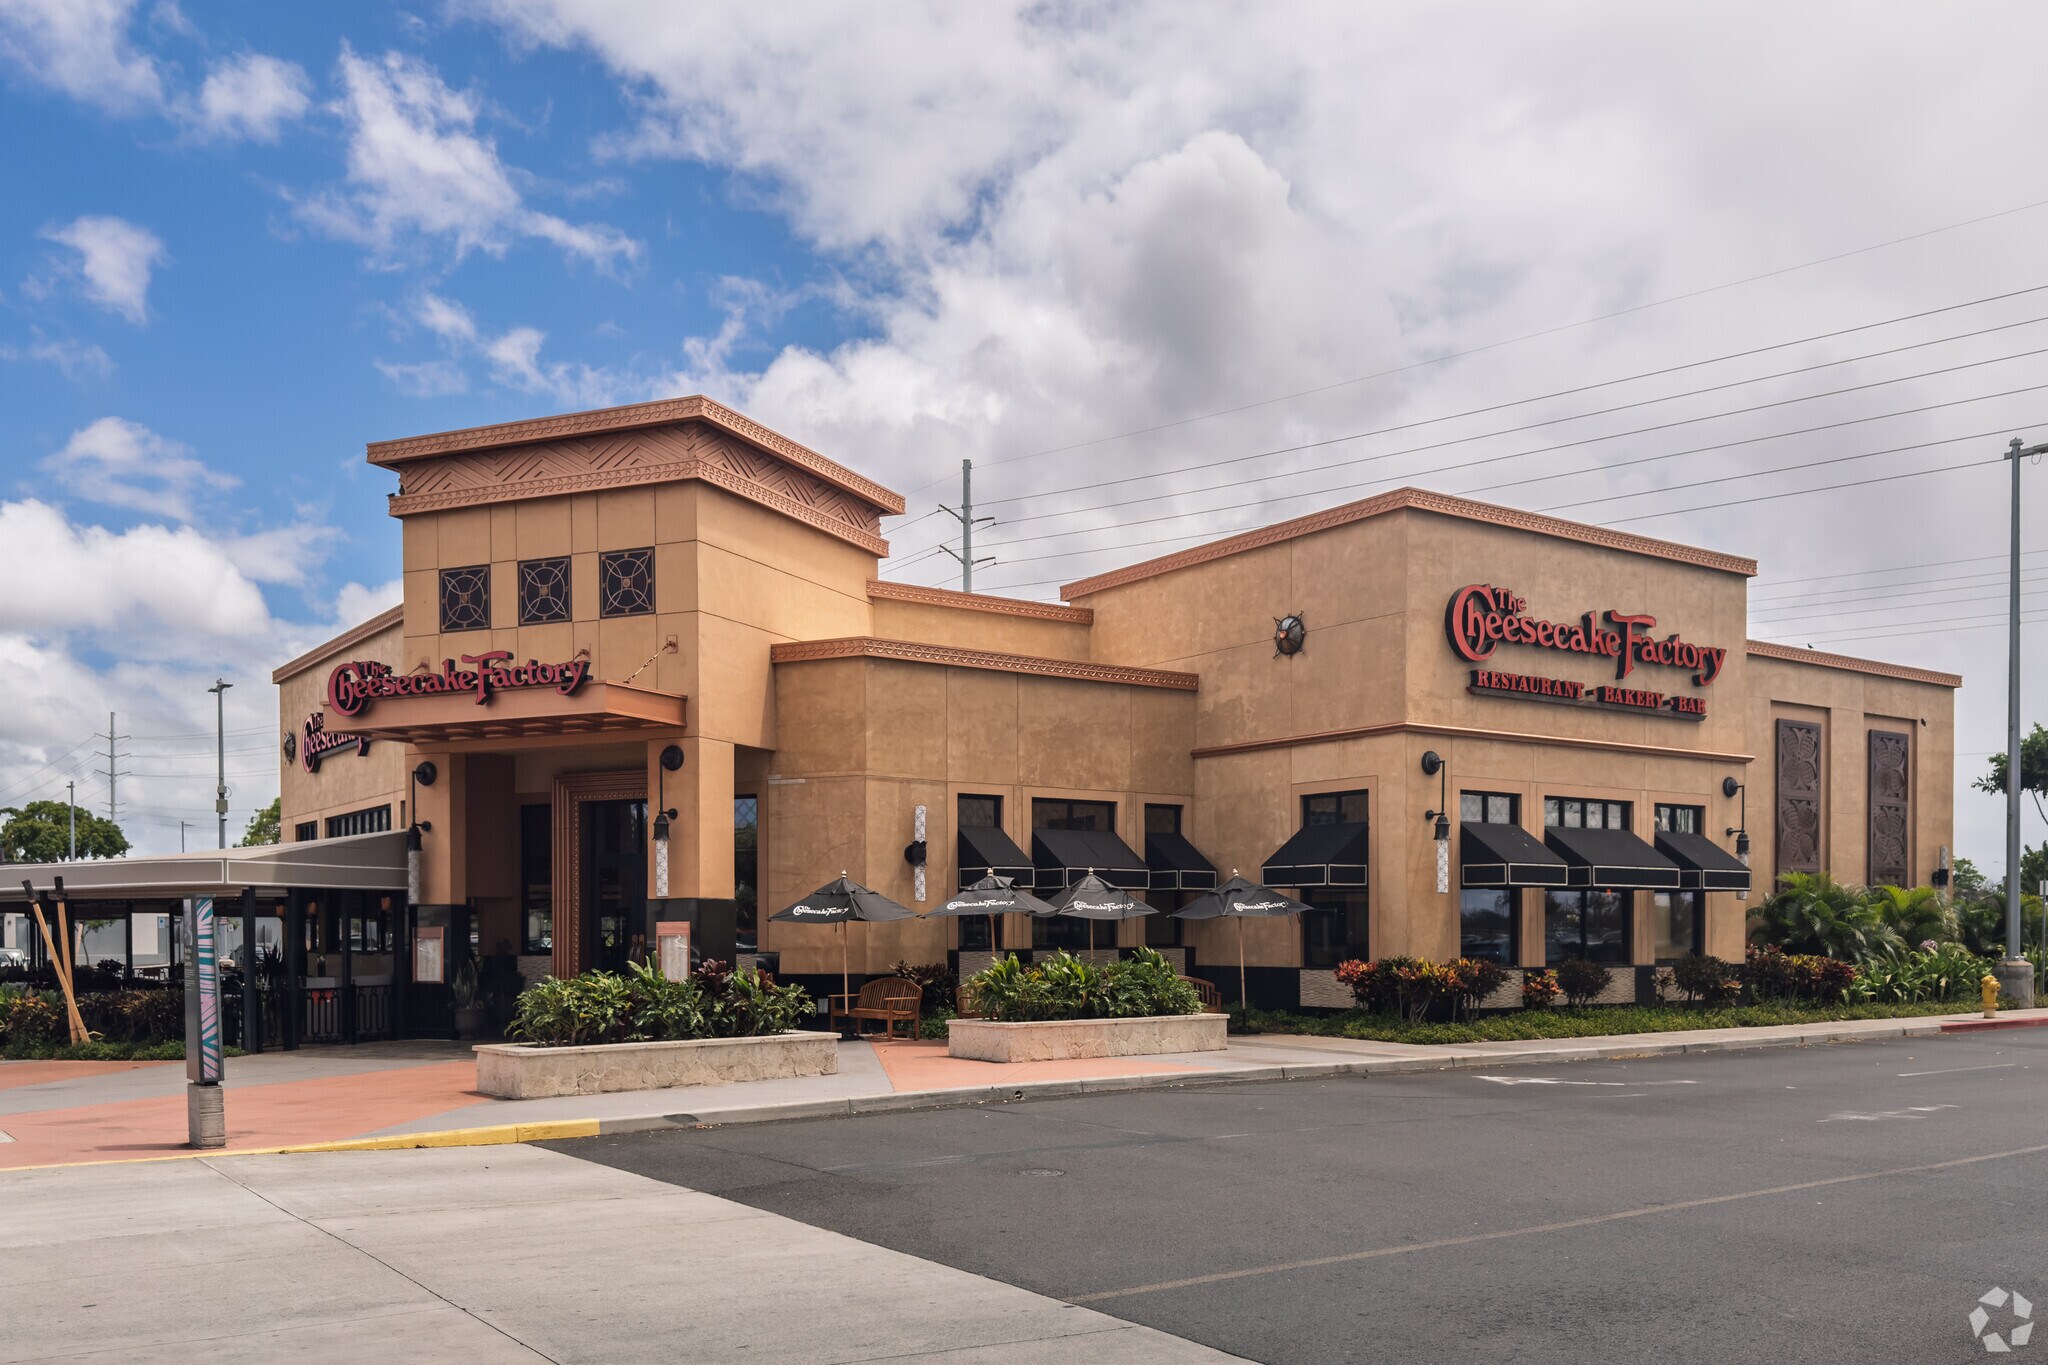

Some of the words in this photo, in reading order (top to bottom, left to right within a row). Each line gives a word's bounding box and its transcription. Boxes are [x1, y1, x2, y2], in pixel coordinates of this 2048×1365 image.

[1495, 588, 1527, 614] The
[1450, 583, 1621, 661] Cheesecake
[1608, 609, 1727, 687] Factory
[328, 658, 475, 716] Cheesecake
[461, 651, 587, 705] Factory
[361, 661, 388, 677] The
[1476, 669, 1585, 699] RESTAURANT
[1604, 686, 1665, 709] BAKERY
[1678, 696, 1707, 714] BAR
[301, 715, 357, 773] Cheeseca
